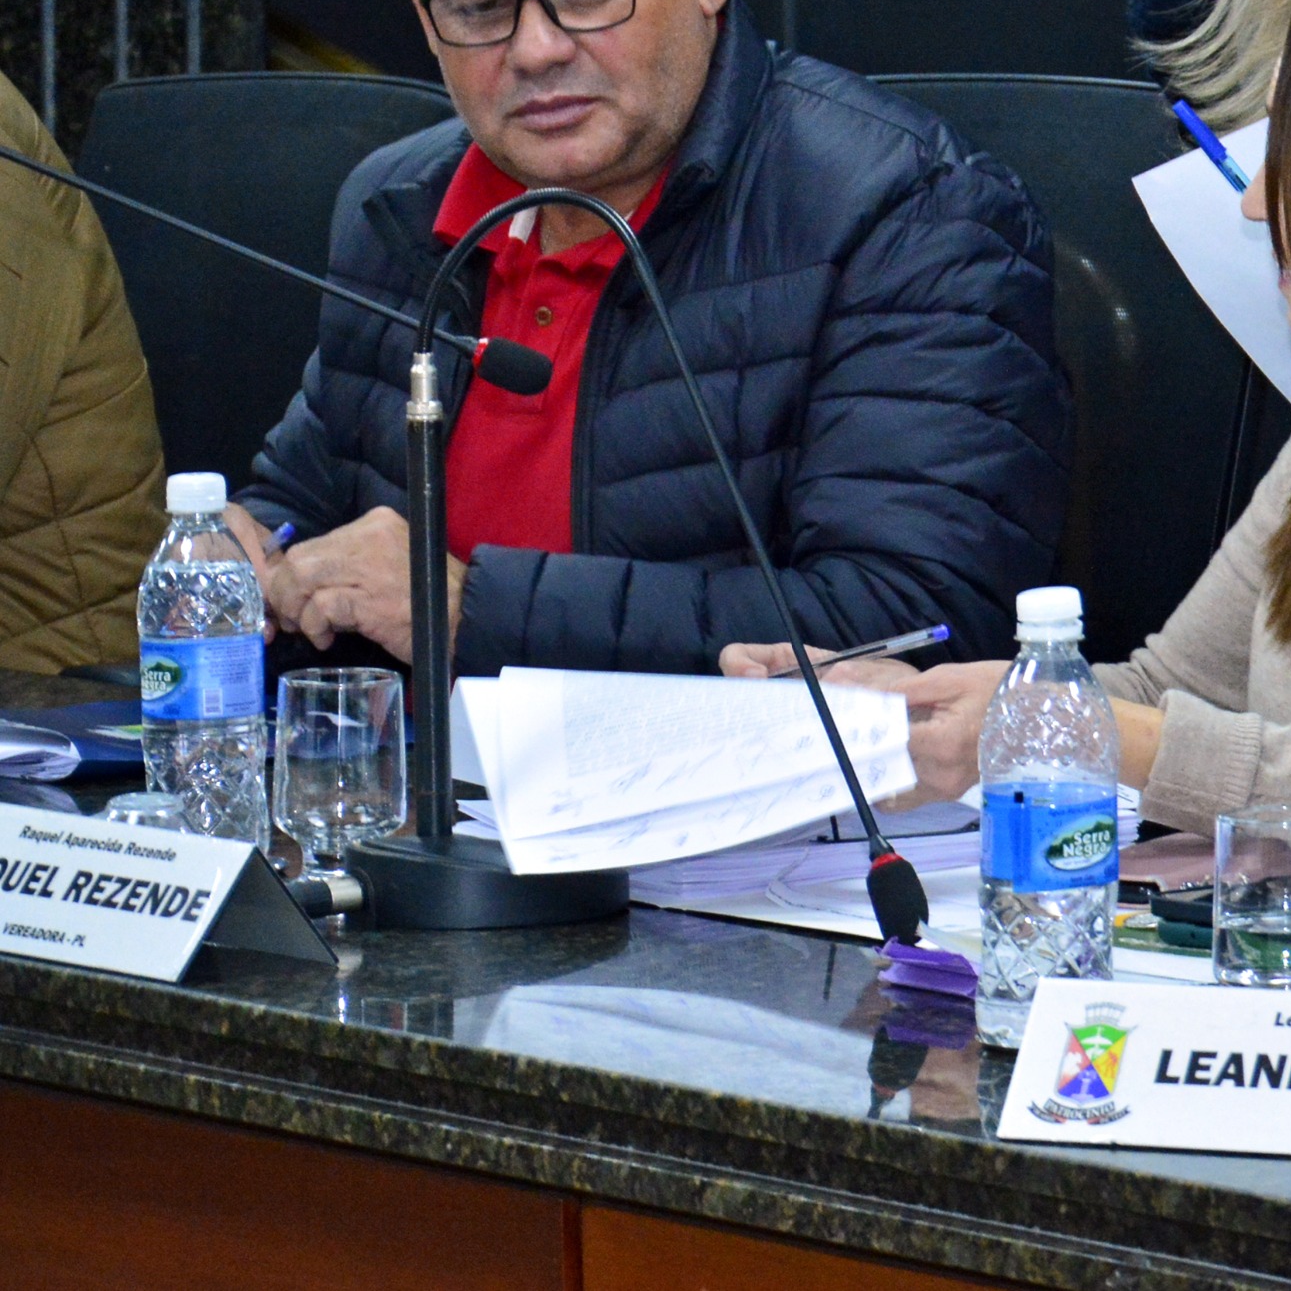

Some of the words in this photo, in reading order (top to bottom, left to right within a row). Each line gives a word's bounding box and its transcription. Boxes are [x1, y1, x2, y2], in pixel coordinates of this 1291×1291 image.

[19, 825, 65, 847] Raquel
[63, 831, 124, 854] Aparecida
[124, 841, 177, 862] Rezende
[1062, 842, 1107, 859] Negra
[1074, 830, 1110, 845] Serra
[61, 869, 212, 923] REZENDE
[2, 922, 65, 943] VEREADORA
[71, 935, 87, 948] PL
